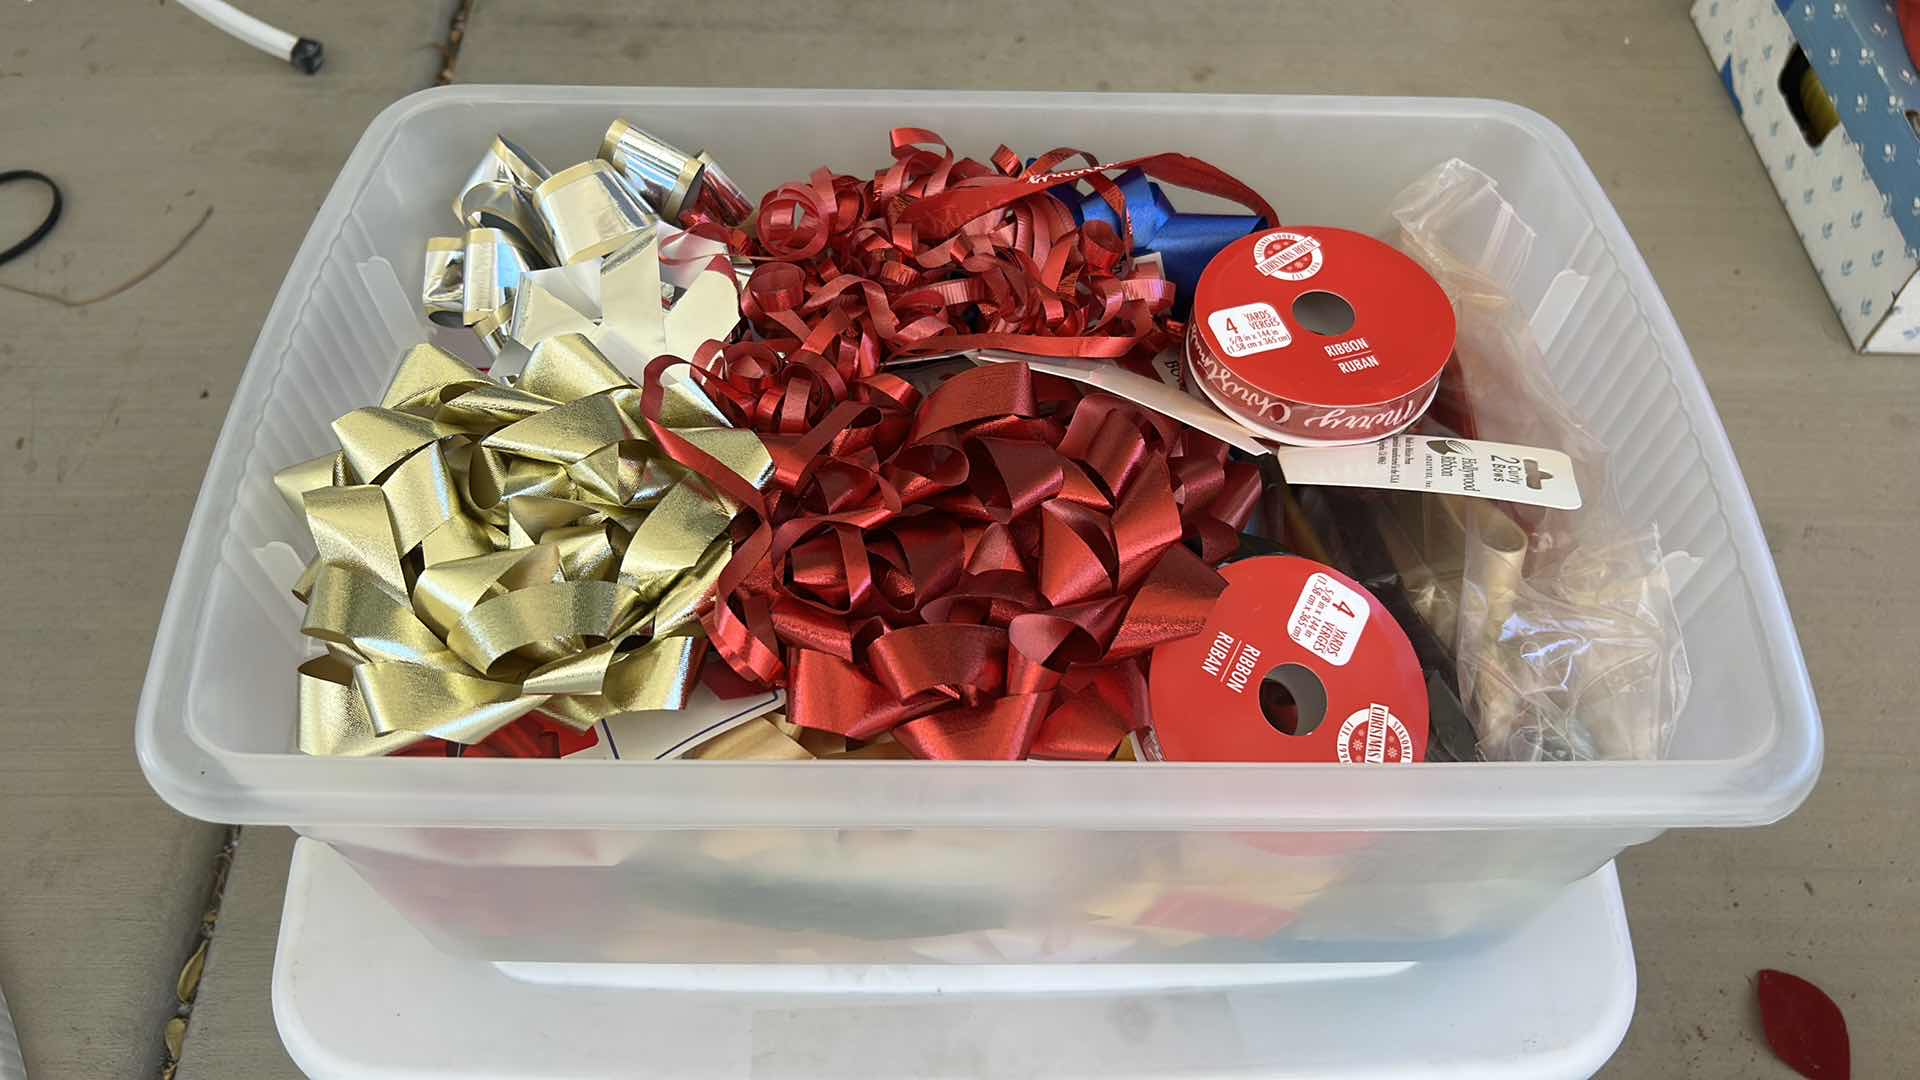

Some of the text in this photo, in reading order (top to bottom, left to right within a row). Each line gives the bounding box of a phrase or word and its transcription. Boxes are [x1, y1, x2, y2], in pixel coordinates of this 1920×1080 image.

[1259, 250, 1297, 275] CHRISTMAS
[1226, 317, 1239, 334] 4
[1245, 309, 1272, 322] YARDS
[1248, 317, 1281, 331] VERGES
[1324, 337, 1369, 358] RIBBON
[1337, 355, 1379, 375] RUBAN
[1304, 399, 1414, 428] Merry
[1440, 455, 1458, 477] Ribbon
[1458, 457, 1481, 492] Hollywood
[1490, 454, 1523, 485] 2 Curly
[1492, 463, 1506, 482] Bows
[1332, 601, 1355, 618] 4
[1312, 621, 1336, 654] VERGES
[1326, 628, 1348, 656] YARDS
[1201, 631, 1234, 677] RUBAN
[1226, 644, 1261, 693] RIBBON
[1367, 706, 1386, 759] CHRISTMAS
[1392, 720, 1411, 760] SEASONAL
